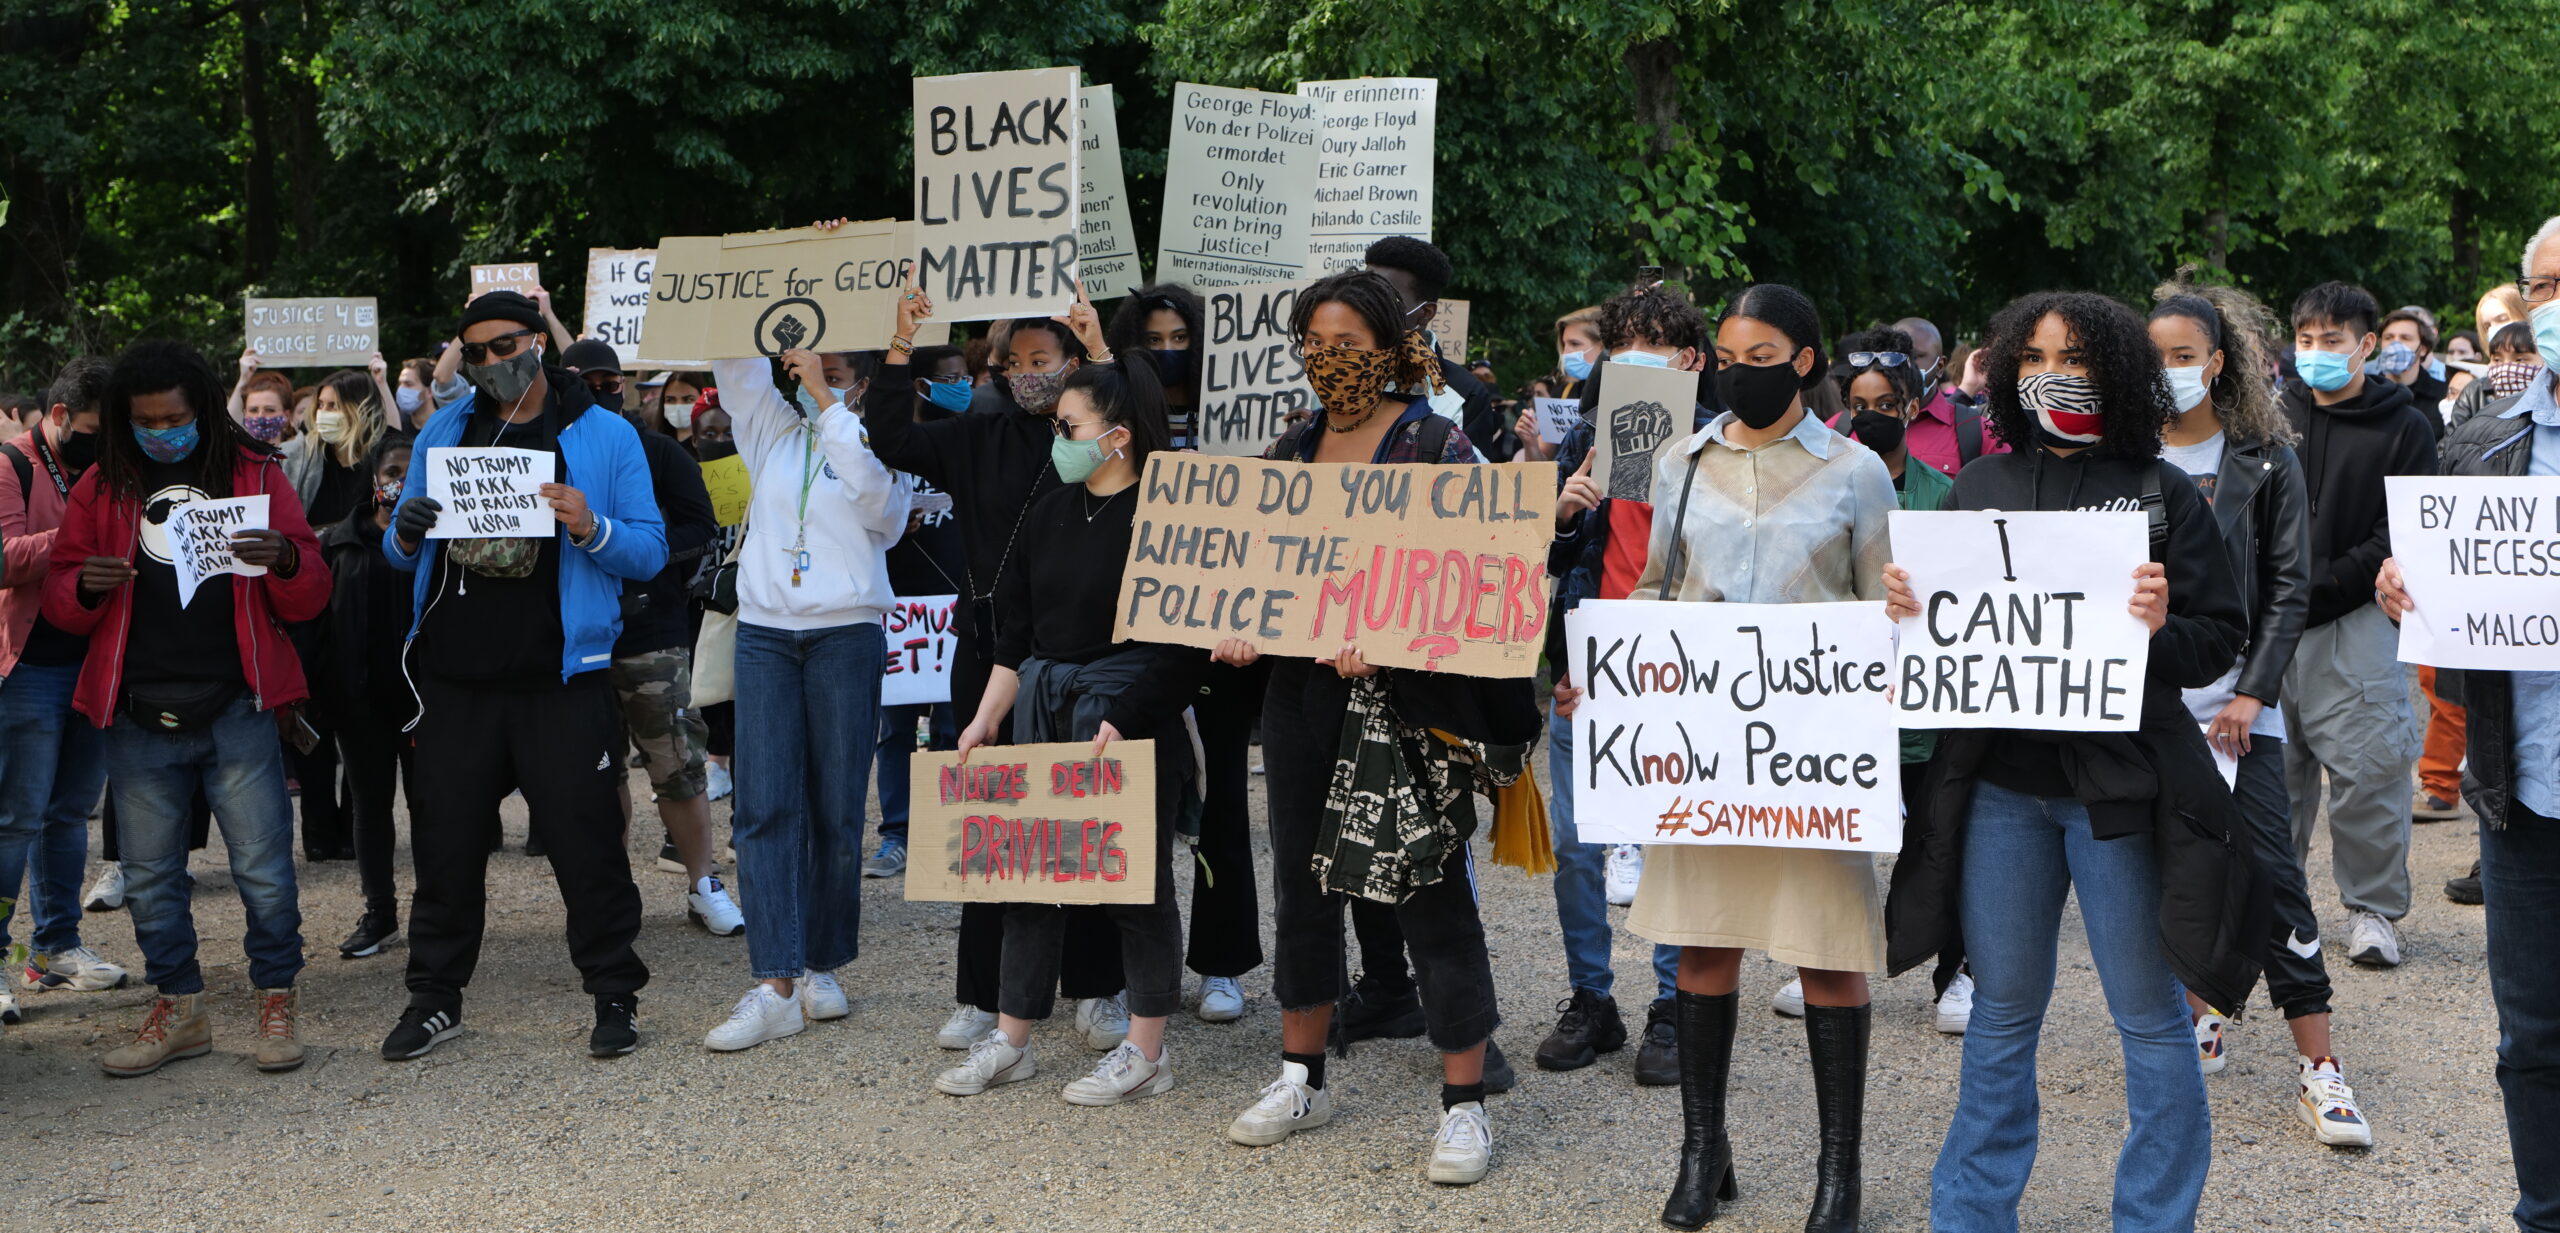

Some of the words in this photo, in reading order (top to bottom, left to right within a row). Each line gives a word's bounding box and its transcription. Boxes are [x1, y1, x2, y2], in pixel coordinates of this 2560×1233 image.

[1307, 86, 1337, 103] Wir
[1344, 84, 1426, 103] erinnern:
[1187, 91, 1253, 117] George
[1260, 98, 1316, 123] Floyd:
[930, 97, 1068, 155] BLACK
[1184, 114, 1216, 135] Von
[1222, 120, 1251, 138] der
[1257, 122, 1314, 146] Polizei
[1322, 115, 1369, 131] eorge
[1375, 110, 1417, 131] Floyd
[1206, 145, 1287, 166] ermordet
[1322, 137, 1358, 158] Oury
[1361, 136, 1406, 152] Jalloh
[1221, 170, 1266, 194] Only
[1319, 162, 1348, 179] Eric
[1353, 161, 1407, 177] Garner
[920, 162, 1070, 226] LIVES
[1192, 193, 1288, 216] revolution
[1368, 185, 1418, 202] Brown
[1193, 214, 1227, 231] can
[1233, 215, 1282, 241] bring
[1370, 209, 1422, 226] Castile
[1198, 233, 1270, 257] justice!
[475, 266, 534, 284] BLACK
[611, 262, 626, 283] If
[634, 260, 654, 285] G
[919, 233, 1078, 302] MATTER
[1172, 254, 1296, 280] Internationalistische
[656, 269, 775, 304] JUSTICE
[784, 267, 824, 297] for
[610, 291, 649, 307] was
[252, 304, 326, 327] JUSTICE
[336, 303, 349, 326] 4
[593, 315, 645, 345] Stil
[253, 335, 317, 356] GEORGE
[327, 333, 372, 352] FLOYD
[1207, 343, 1306, 393] LIVES
[1203, 386, 1309, 445] MATTER
[1547, 403, 1563, 416] NO
[1551, 417, 1566, 426] NO
[1614, 408, 1667, 434] SAY
[47, 463, 59, 474] 5D
[445, 455, 470, 477] NO
[471, 455, 532, 475] TRUMP
[53, 473, 68, 493] EOS
[449, 480, 471, 498] NO
[475, 475, 516, 495] KKK
[1146, 458, 1240, 507] WHO
[1257, 467, 1314, 517] DO
[1340, 465, 1413, 521] YOU
[1430, 465, 1541, 524] CALL
[453, 497, 477, 514] NO
[480, 493, 538, 513] RACIST
[2420, 494, 2457, 530] BY
[2475, 495, 2539, 533] ANY
[173, 516, 186, 540] NO
[183, 505, 246, 525] TRUMP
[467, 513, 521, 536] USA!!!
[181, 537, 191, 558] NO
[188, 526, 229, 545] KKK
[1134, 519, 1250, 570] WHEN
[1267, 534, 1350, 577] THE
[1993, 519, 2017, 582] I
[1126, 576, 1296, 640] POLICE
[1308, 544, 1547, 644] MURDERS
[1927, 590, 2086, 650] CAN'T
[1586, 629, 1720, 701] K(no)w
[1730, 621, 1888, 712] Justice
[1900, 654, 2128, 721] BREATHE
[1588, 719, 1719, 790] K(no)w
[1745, 720, 1878, 789] Peace
[939, 762, 1028, 806] NUTZE
[1051, 760, 1122, 798] DEIN
[1655, 795, 1863, 843] #SAYMYNAME
[961, 814, 1127, 884] PRIVILEG
[2328, 1084, 2346, 1094] NIKE
